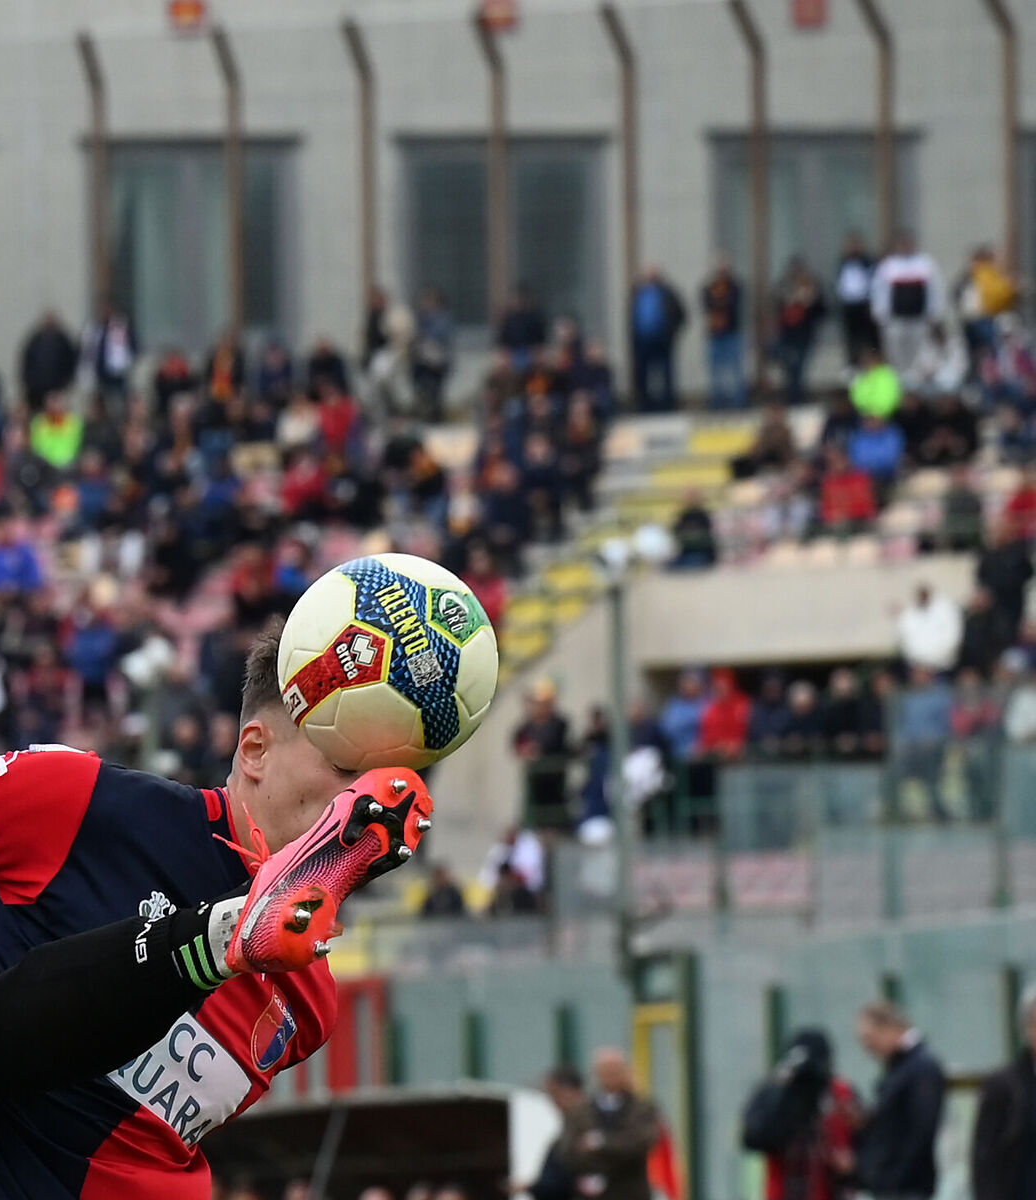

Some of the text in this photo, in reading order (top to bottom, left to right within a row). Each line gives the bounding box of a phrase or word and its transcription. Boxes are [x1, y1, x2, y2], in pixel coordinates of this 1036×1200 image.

[374, 583, 429, 655] TALENTO
[168, 1022, 217, 1083] CC
[118, 1051, 212, 1148] UARA
